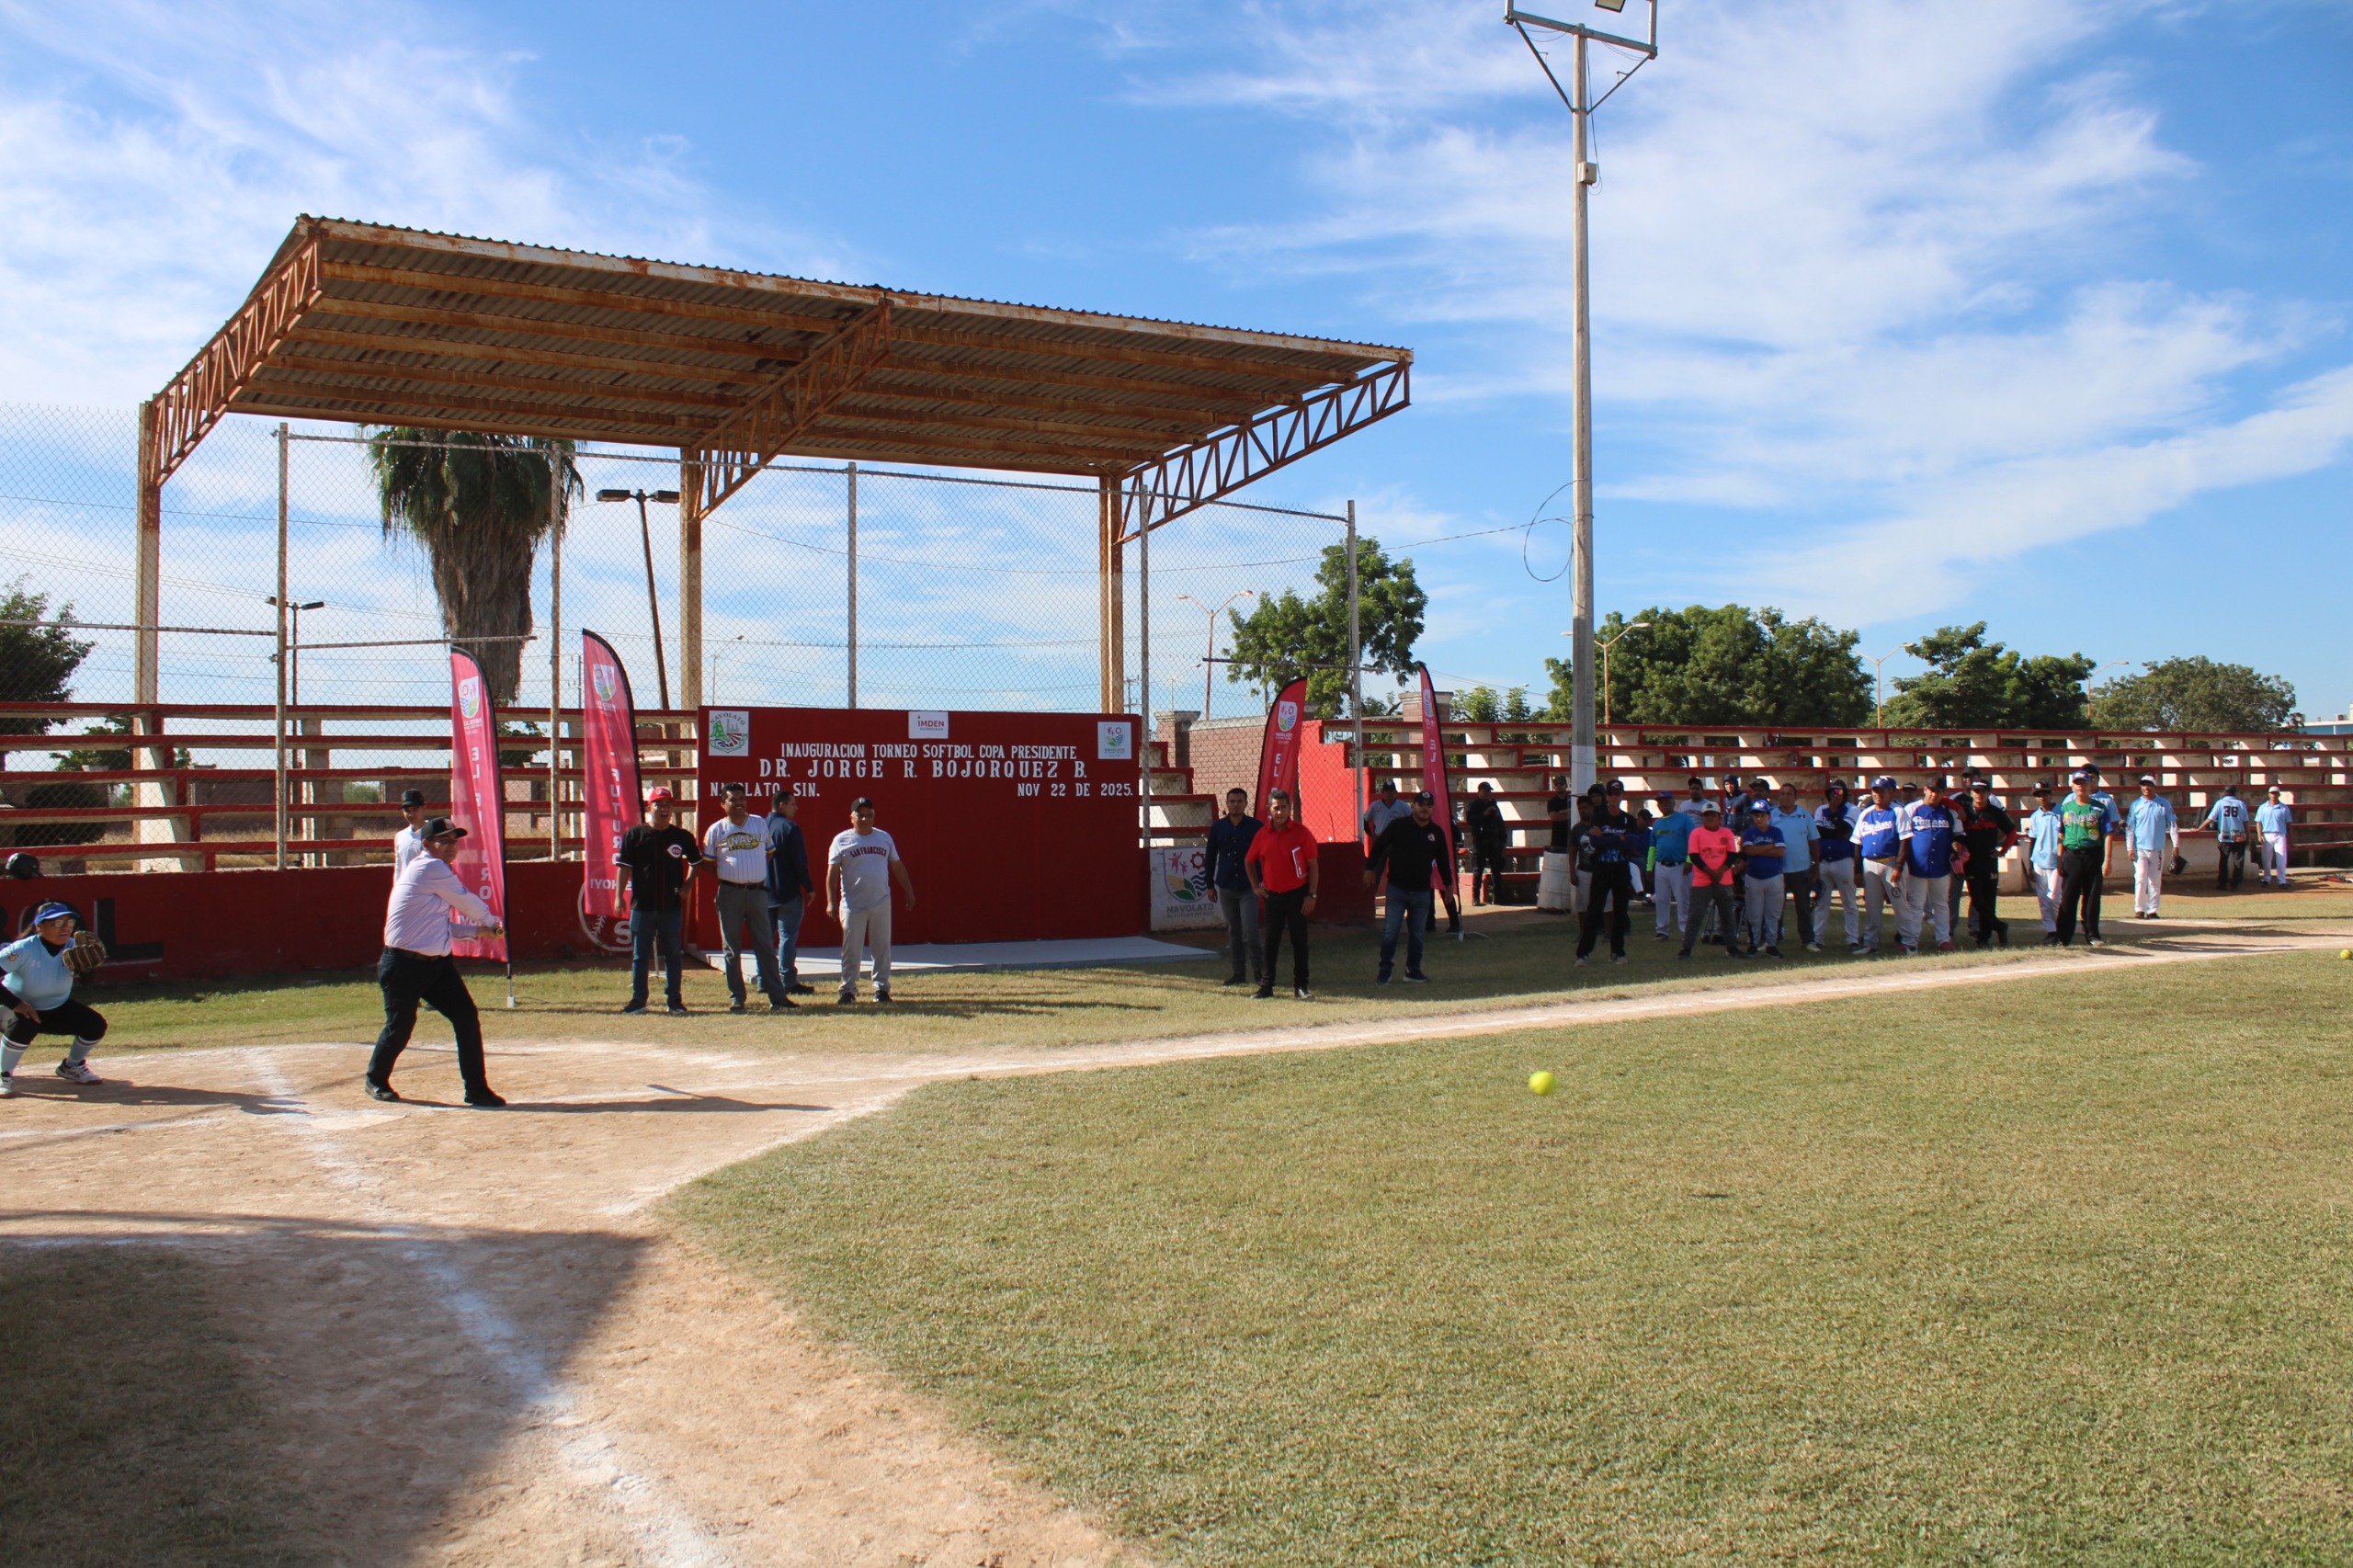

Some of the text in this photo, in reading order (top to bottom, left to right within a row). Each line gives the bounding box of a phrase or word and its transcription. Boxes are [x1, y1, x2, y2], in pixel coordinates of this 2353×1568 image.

[710, 712, 745, 725] NAVOLATO
[781, 743, 1077, 760] INAUGURACION TORNEO SOFTBOL COPA PRESIDENTE
[759, 758, 1087, 778] DR. JORGE R. BOJORQUEZ B.
[1273, 753, 1282, 778] EL
[710, 781, 821, 797] NLATO SIN.
[1017, 783, 1133, 797] NOV 22 DE 2025.
[1166, 903, 1214, 914] NAVOLATO
